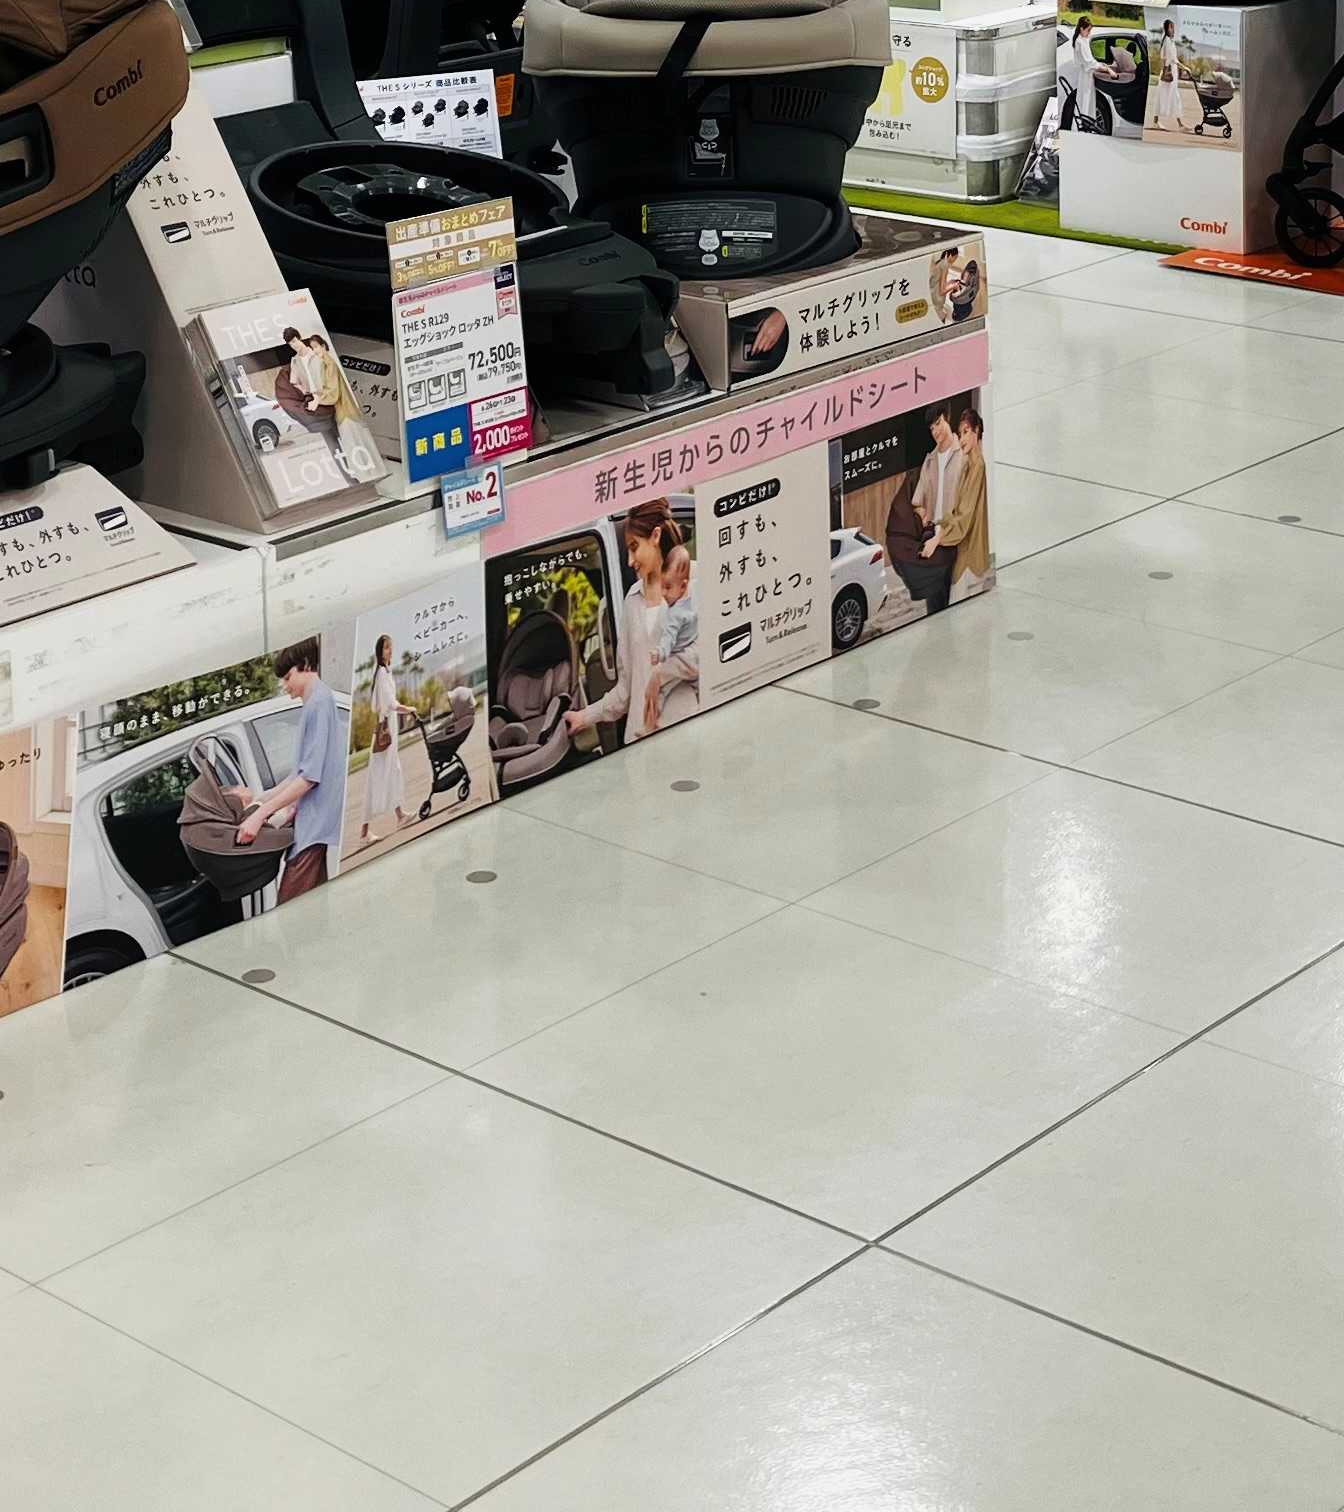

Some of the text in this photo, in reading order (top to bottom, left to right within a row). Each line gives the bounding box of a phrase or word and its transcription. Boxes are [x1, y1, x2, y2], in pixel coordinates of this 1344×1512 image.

[892, 34, 912, 47] 守る
[93, 59, 143, 107] Combi
[377, 85, 393, 93] THE
[403, 80, 432, 89] シリーズ
[436, 76, 477, 87] 商品比較表
[149, 188, 226, 211] これひとつ。
[1180, 217, 1228, 235] Combi
[1193, 255, 1312, 281] Combi
[401, 305, 425, 318] Combi
[799, 277, 911, 326] マルチグリップを
[402, 313, 449, 334] THE S R129
[404, 315, 494, 348] エッグショック ロッタ ZH
[468, 342, 521, 370] 72,500円
[415, 426, 462, 456] 新商品
[474, 425, 510, 455] 2,000
[594, 366, 928, 505] 新生児からのチャイルドシート
[843, 435, 898, 466] お部屋とクルマを
[278, 445, 375, 495] Lotta
[844, 461, 884, 482] スムーズに。
[718, 513, 778, 548] 回すも、
[503, 548, 589, 589] 抱っこしながらでも、
[719, 548, 779, 584] 外すも、
[504, 581, 556, 606] 乗せやすい。
[720, 571, 814, 617] これひとつ。
[414, 597, 456, 625] クルマから
[759, 599, 813, 634] マルチグリップ
[414, 633, 469, 662] シームレスに。
[98, 685, 251, 740] 寝顔のまま、移動ができる。
